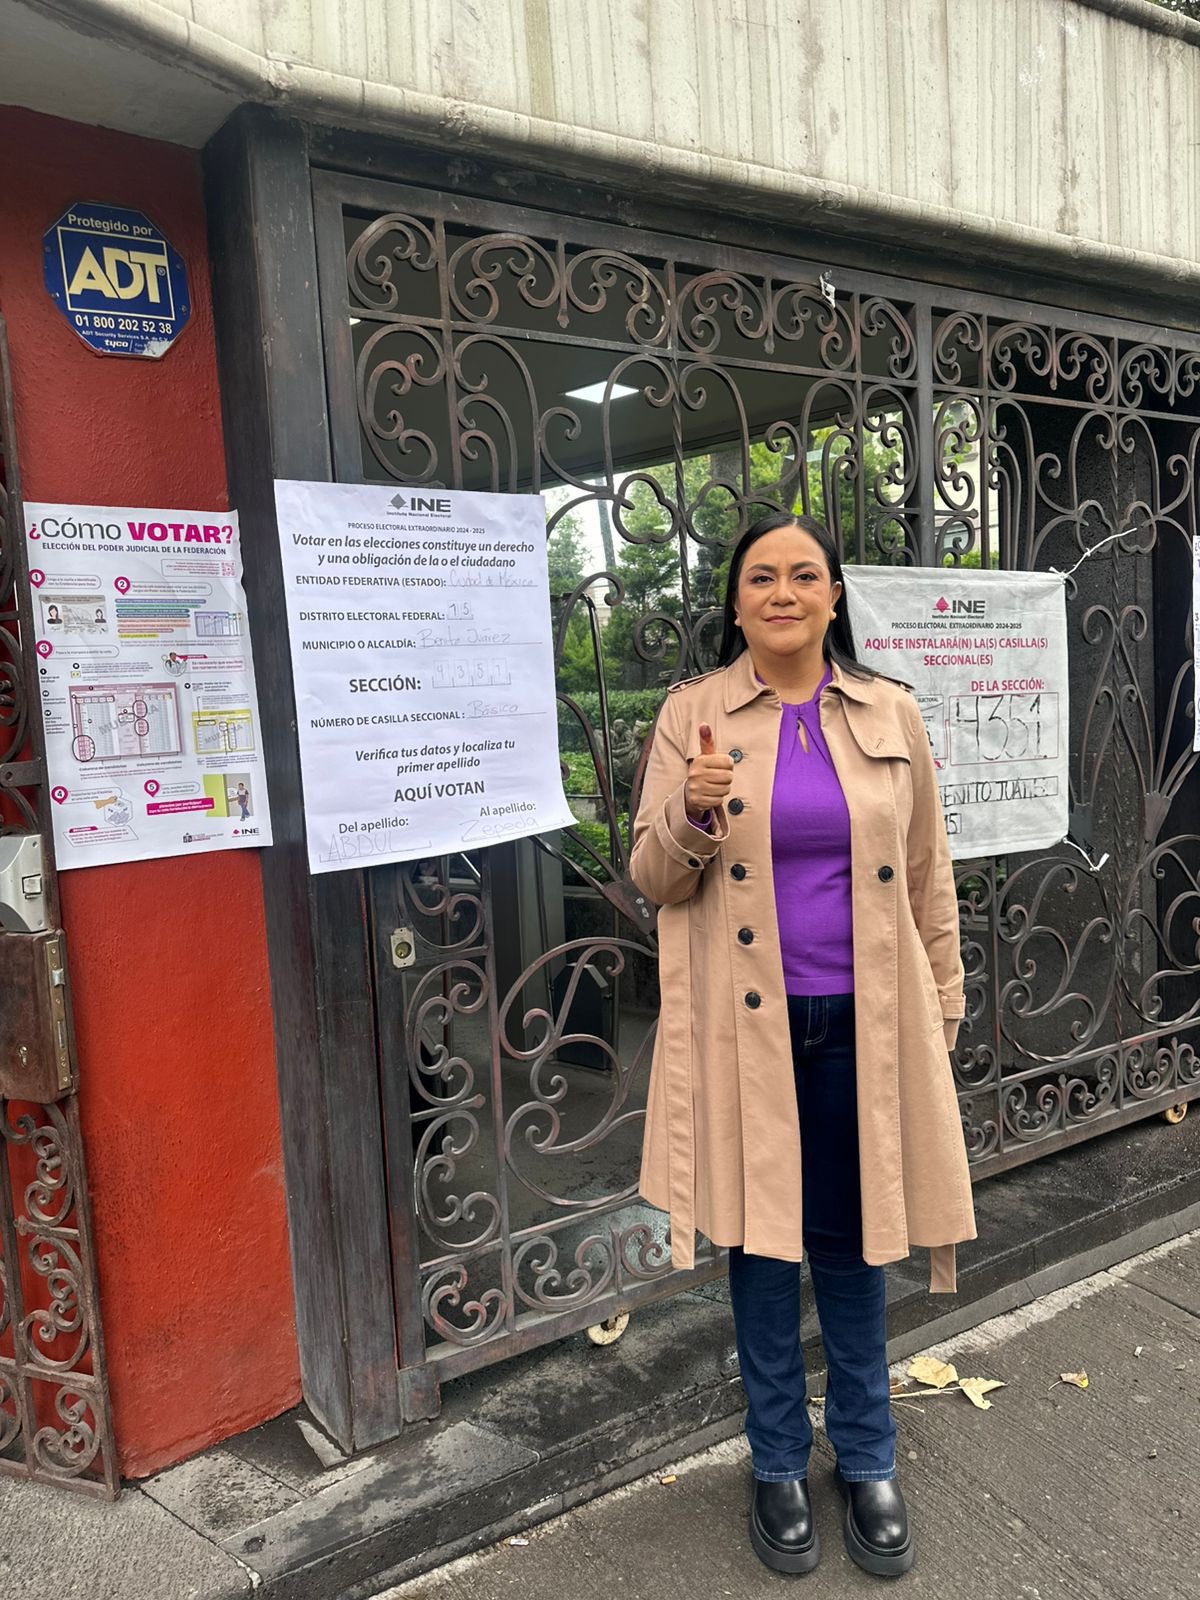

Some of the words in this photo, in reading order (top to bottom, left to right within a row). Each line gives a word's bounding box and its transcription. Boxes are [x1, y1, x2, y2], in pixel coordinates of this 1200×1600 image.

[68, 214, 129, 232] Protegido
[133, 225, 153, 236] por
[69, 246, 167, 303] ADT
[75, 315, 89, 326] 01
[93, 316, 114, 329] 800
[118, 319, 139, 331] 202
[143, 321, 155, 332] 52
[159, 323, 172, 334] 38
[104, 340, 128, 348] tyco
[411, 497, 451, 512] INE
[29, 517, 121, 540] ¿Cómo
[127, 522, 233, 544] VOTAR?
[348, 522, 374, 530] PROCESO
[408, 525, 455, 533] EXTRAORDINARIO
[42, 542, 80, 550] ELECCIÓN
[83, 543, 96, 551] DEL
[183, 546, 226, 555] FEDERACIÓN
[293, 534, 326, 547] Votar
[328, 537, 342, 547] en
[345, 535, 361, 547] las
[364, 536, 420, 549] elecciones
[422, 540, 476, 554] constituye
[478, 543, 492, 551] un
[494, 541, 534, 552] derecho
[318, 554, 324, 565] y
[327, 554, 349, 564] una
[352, 553, 411, 567] obligación
[414, 555, 427, 565] de
[429, 555, 439, 566] la
[441, 558, 448, 566] o
[450, 555, 459, 566] el
[461, 556, 515, 567] ciudadano
[296, 575, 340, 585] ENTIDAD
[343, 576, 400, 586] FEDERATIVA
[402, 576, 446, 587] (ESTADO):
[952, 600, 985, 613] INE
[300, 612, 344, 621] DISTRITO
[347, 612, 400, 621] ELECTORAL
[403, 612, 444, 620] FEDERAL:
[303, 640, 355, 650] MUNICIPIO
[358, 640, 365, 649] O
[367, 638, 416, 649] ALCALDÍA:
[865, 636, 891, 651] AQUÍ
[892, 639, 904, 649] SE
[906, 636, 972, 649] INSTALARÁ(N)
[974, 639, 997, 649] LA(S)
[999, 637, 1048, 649] CASILLA(S)
[924, 654, 993, 666] SECCIONAL(ES)
[350, 675, 421, 693] SECCIÓN:
[971, 681, 984, 692] DE
[986, 680, 999, 691] LA
[1002, 677, 1045, 690] SECCIÓN:
[311, 717, 355, 728] NÚMERO
[357, 716, 369, 725] DE
[372, 714, 409, 724] CASILLA
[411, 712, 460, 723] SECCIONAL
[356, 748, 398, 761] Verifica
[401, 747, 418, 758] tus
[420, 744, 451, 756] datos
[453, 746, 460, 755] y
[462, 740, 502, 753] localiza
[504, 739, 515, 749] tu
[397, 763, 434, 776] primer
[437, 757, 480, 772] apellido
[394, 784, 432, 802] AQUÍ
[435, 781, 485, 798] VOTAN
[940, 782, 992, 807] ENITO
[479, 807, 489, 816] Al
[492, 802, 536, 816] apellido:
[339, 822, 358, 834] Del
[361, 818, 409, 833] apellido:
